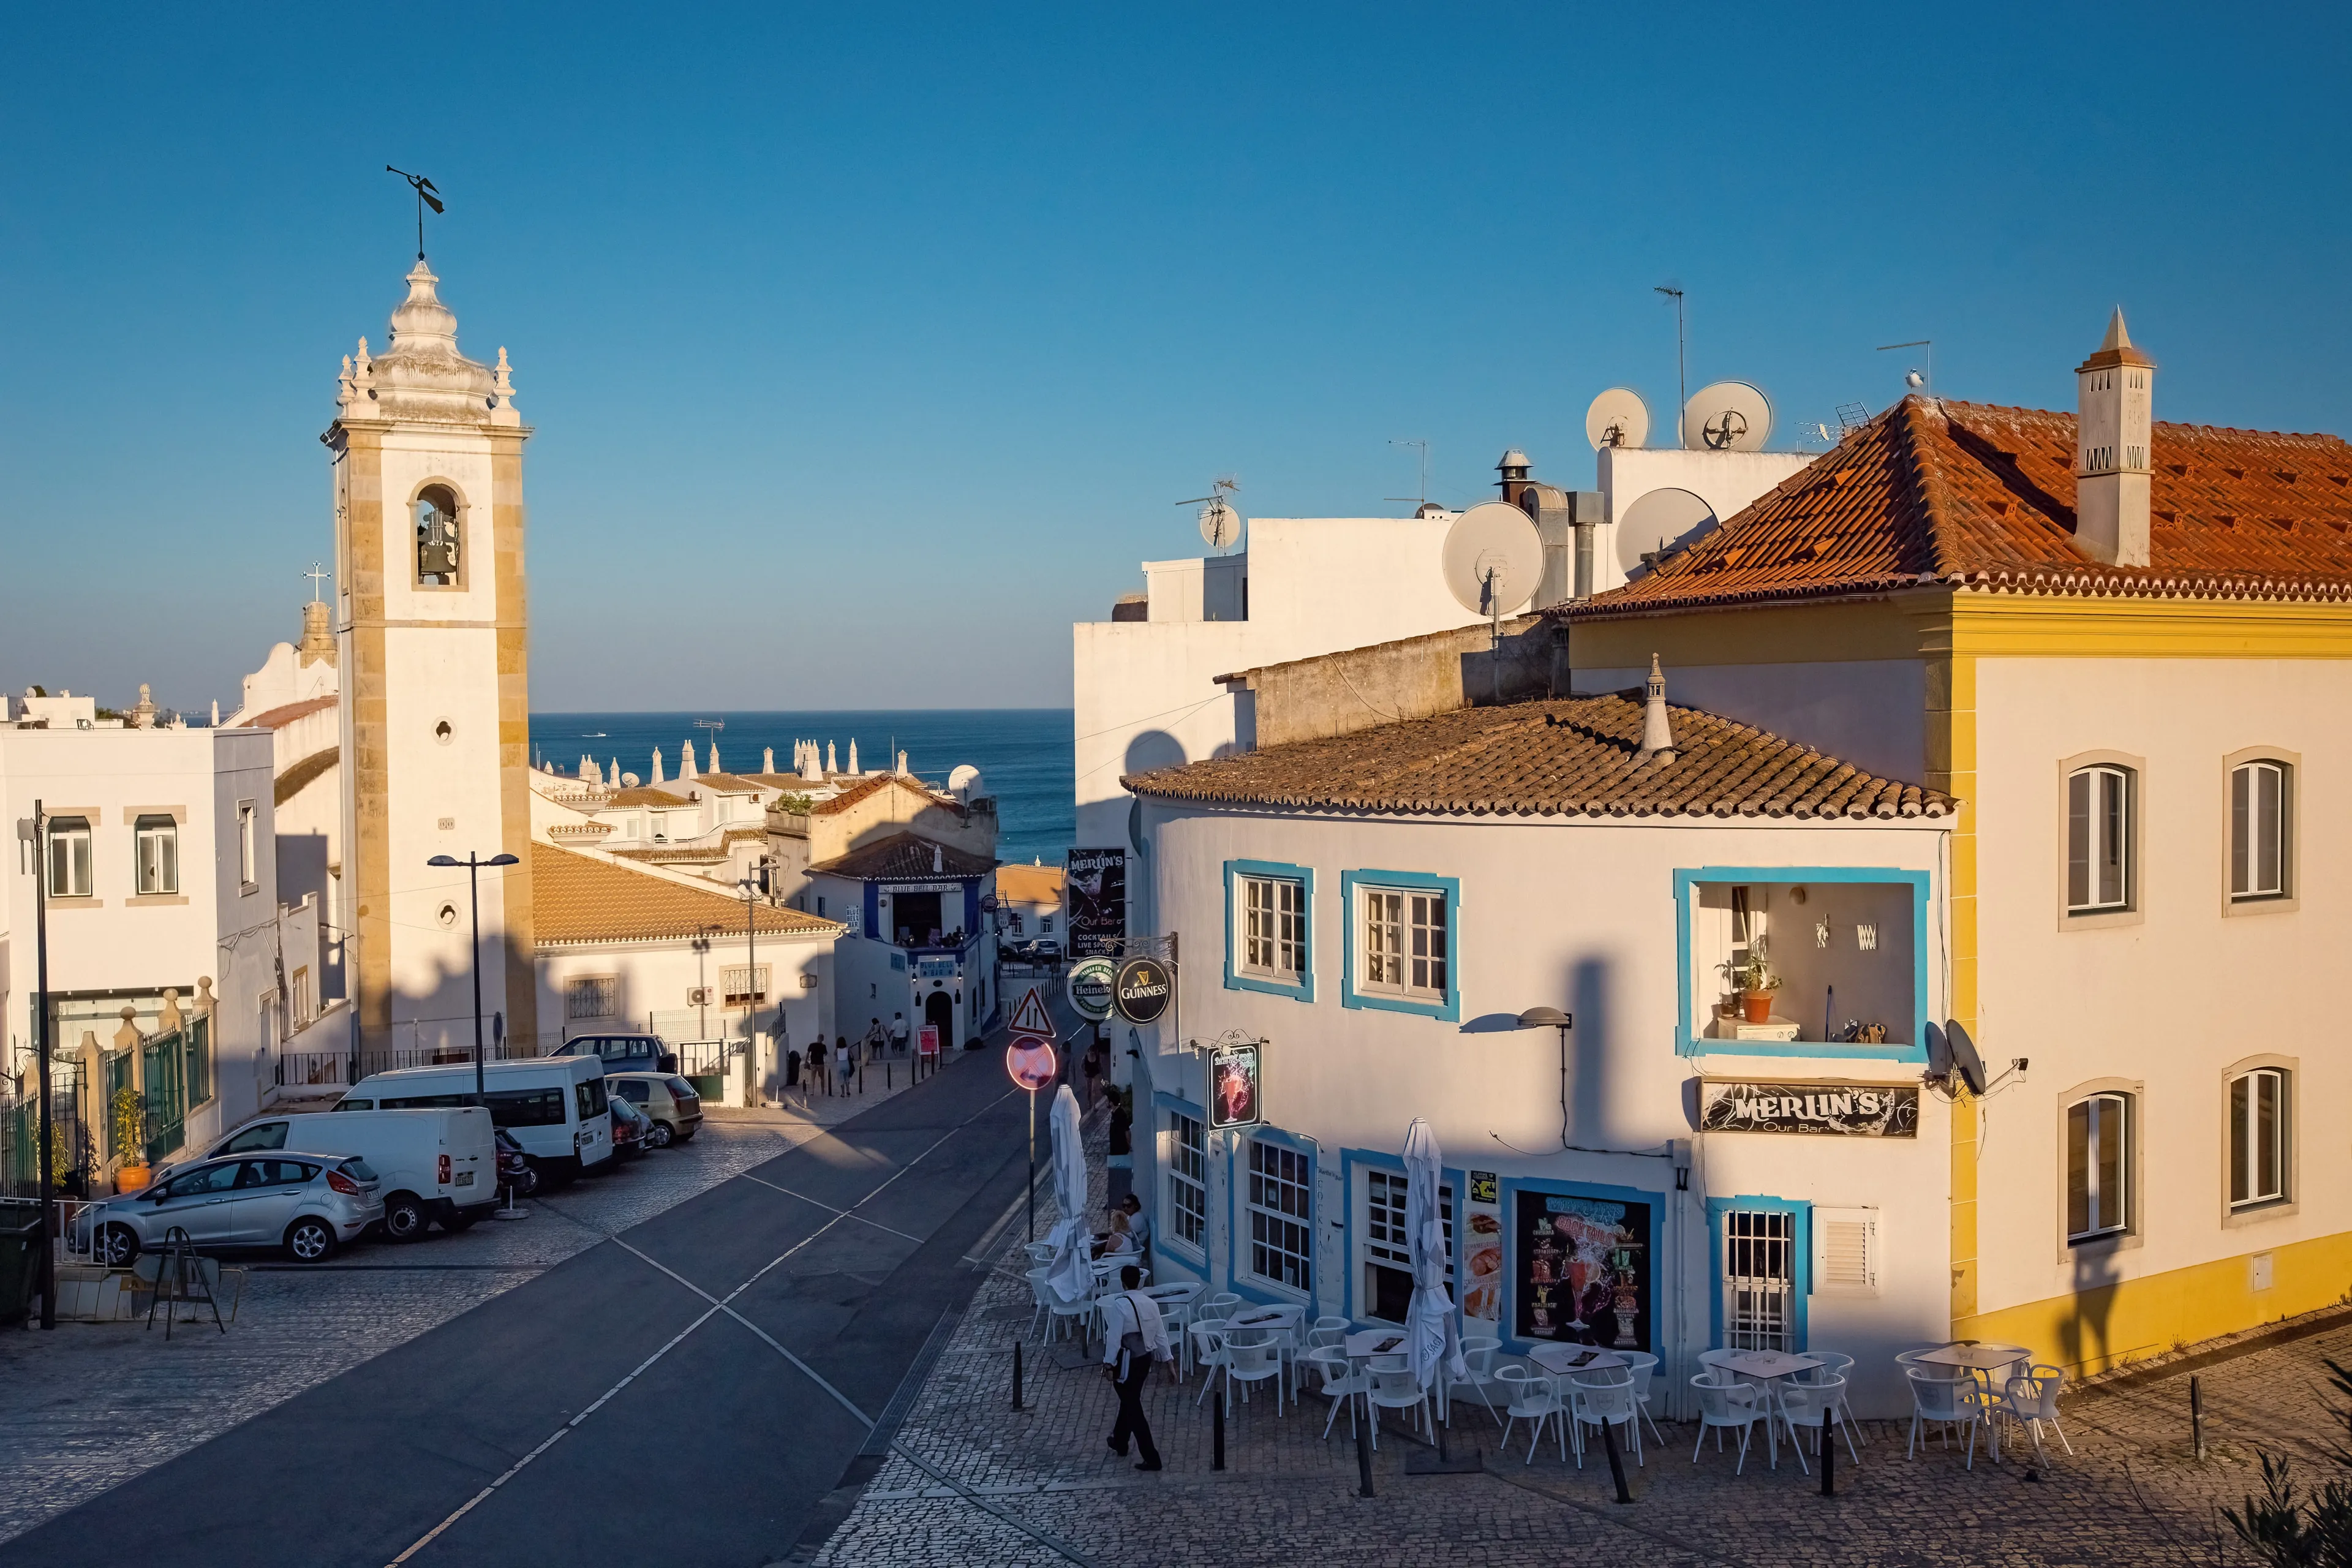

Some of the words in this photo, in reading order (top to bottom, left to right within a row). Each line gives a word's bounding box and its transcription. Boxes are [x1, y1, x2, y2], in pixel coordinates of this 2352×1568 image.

[1071, 856, 1123, 872] MERLIN'S
[1081, 916, 1098, 926] Our
[1076, 985, 1111, 995] Heinek
[1121, 984, 1167, 1000] GUINNESS
[1735, 1090, 1880, 1122] MERLIN'S
[1763, 1121, 1793, 1133] Our
[1798, 1123, 1824, 1134] Bar
[1427, 1339, 1441, 1355] SAG
